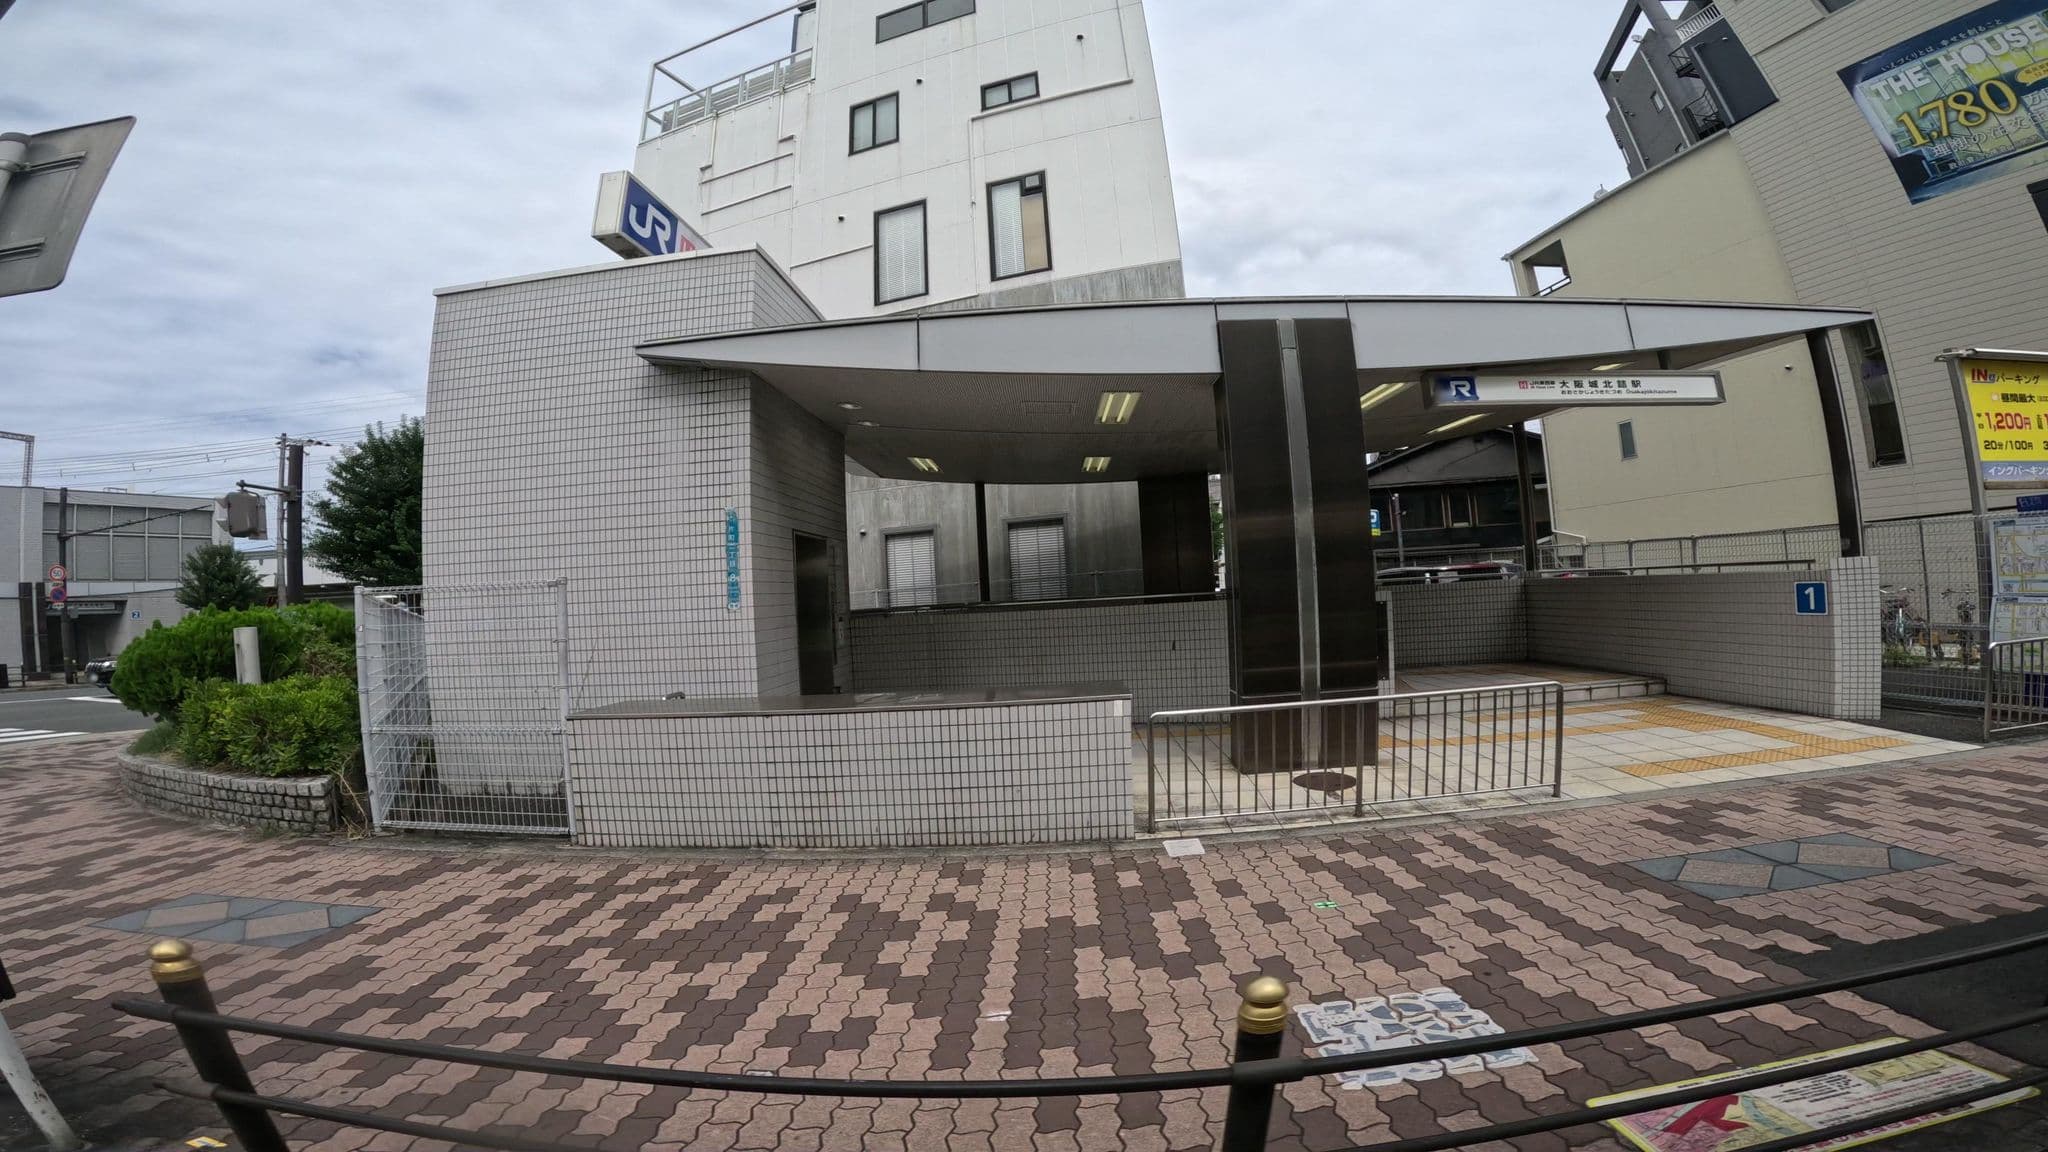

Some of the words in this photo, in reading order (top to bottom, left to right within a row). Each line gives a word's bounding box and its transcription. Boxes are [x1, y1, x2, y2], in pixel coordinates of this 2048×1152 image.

[1870, 65, 1931, 101] THE
[1938, 20, 2048, 75] HOUSE
[1896, 79, 2019, 147] 1,780
[629, 203, 671, 254] JR
[1560, 379, 1641, 388] 大阪城北詰駅
[1805, 587, 1815, 610] 1
